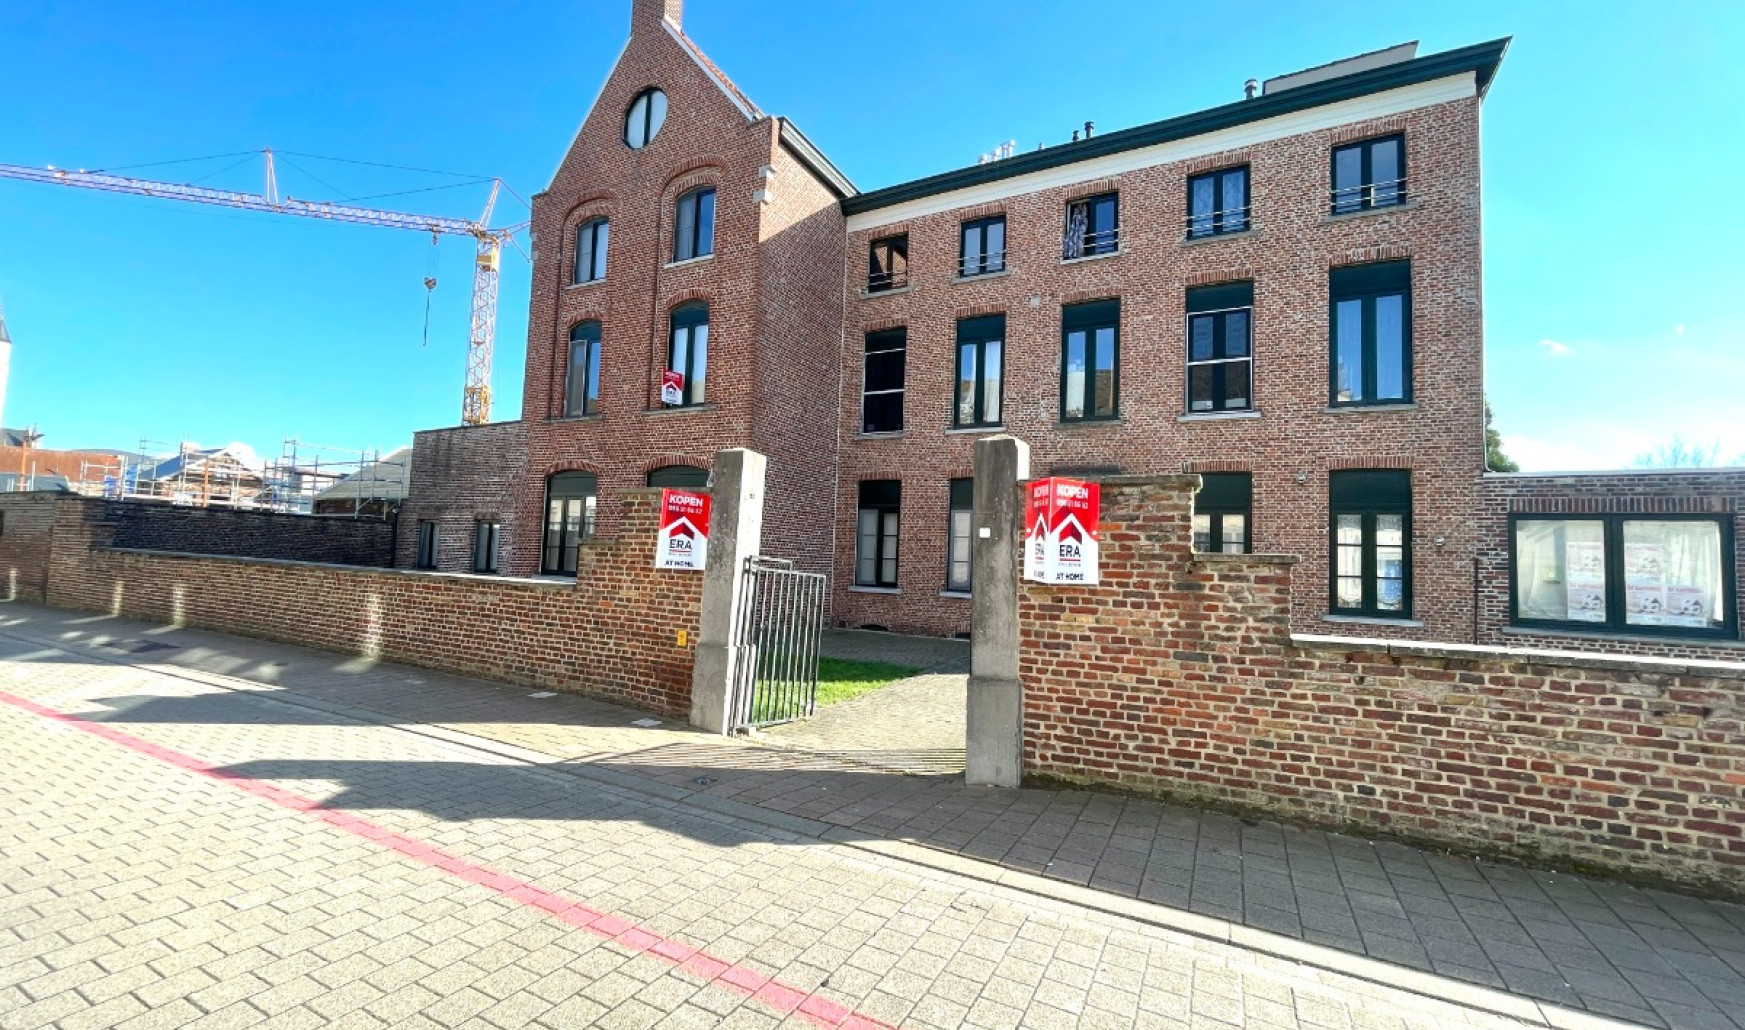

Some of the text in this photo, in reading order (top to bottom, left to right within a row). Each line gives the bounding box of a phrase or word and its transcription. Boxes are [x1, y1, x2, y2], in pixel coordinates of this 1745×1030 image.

[1056, 484, 1088, 499] KOPEN
[669, 494, 704, 507] KOPEN
[669, 539, 692, 549] ERA
[1059, 545, 1081, 557] ERA
[1056, 572, 1084, 581] AT HOME
